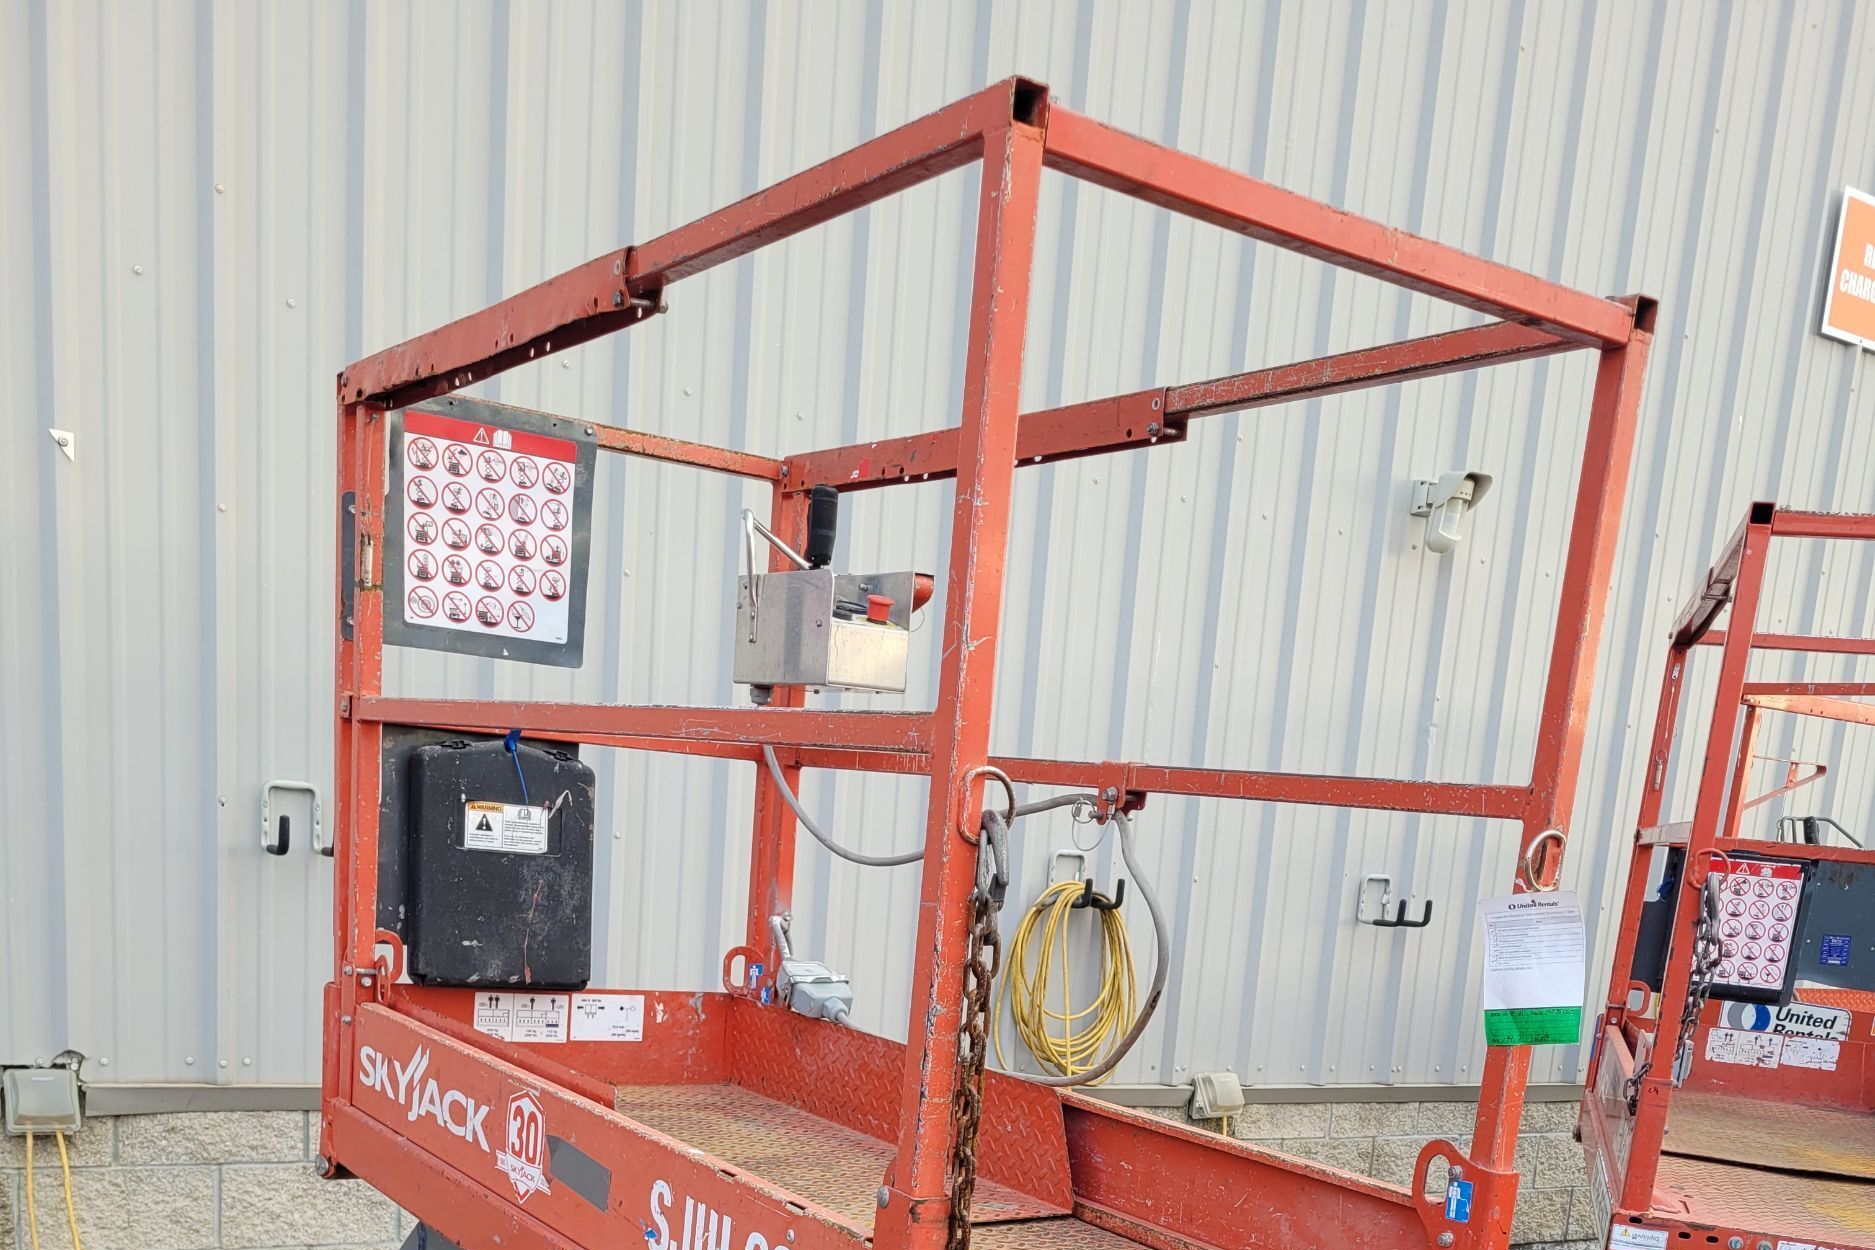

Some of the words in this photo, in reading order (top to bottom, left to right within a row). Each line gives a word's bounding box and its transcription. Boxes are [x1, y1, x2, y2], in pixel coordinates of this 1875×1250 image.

[1517, 901, 1536, 910] United
[1538, 901, 1558, 909] Rentals
[1775, 1006, 1838, 1030] United
[359, 1043, 490, 1153] SKYJACK
[510, 1104, 540, 1166] 30
